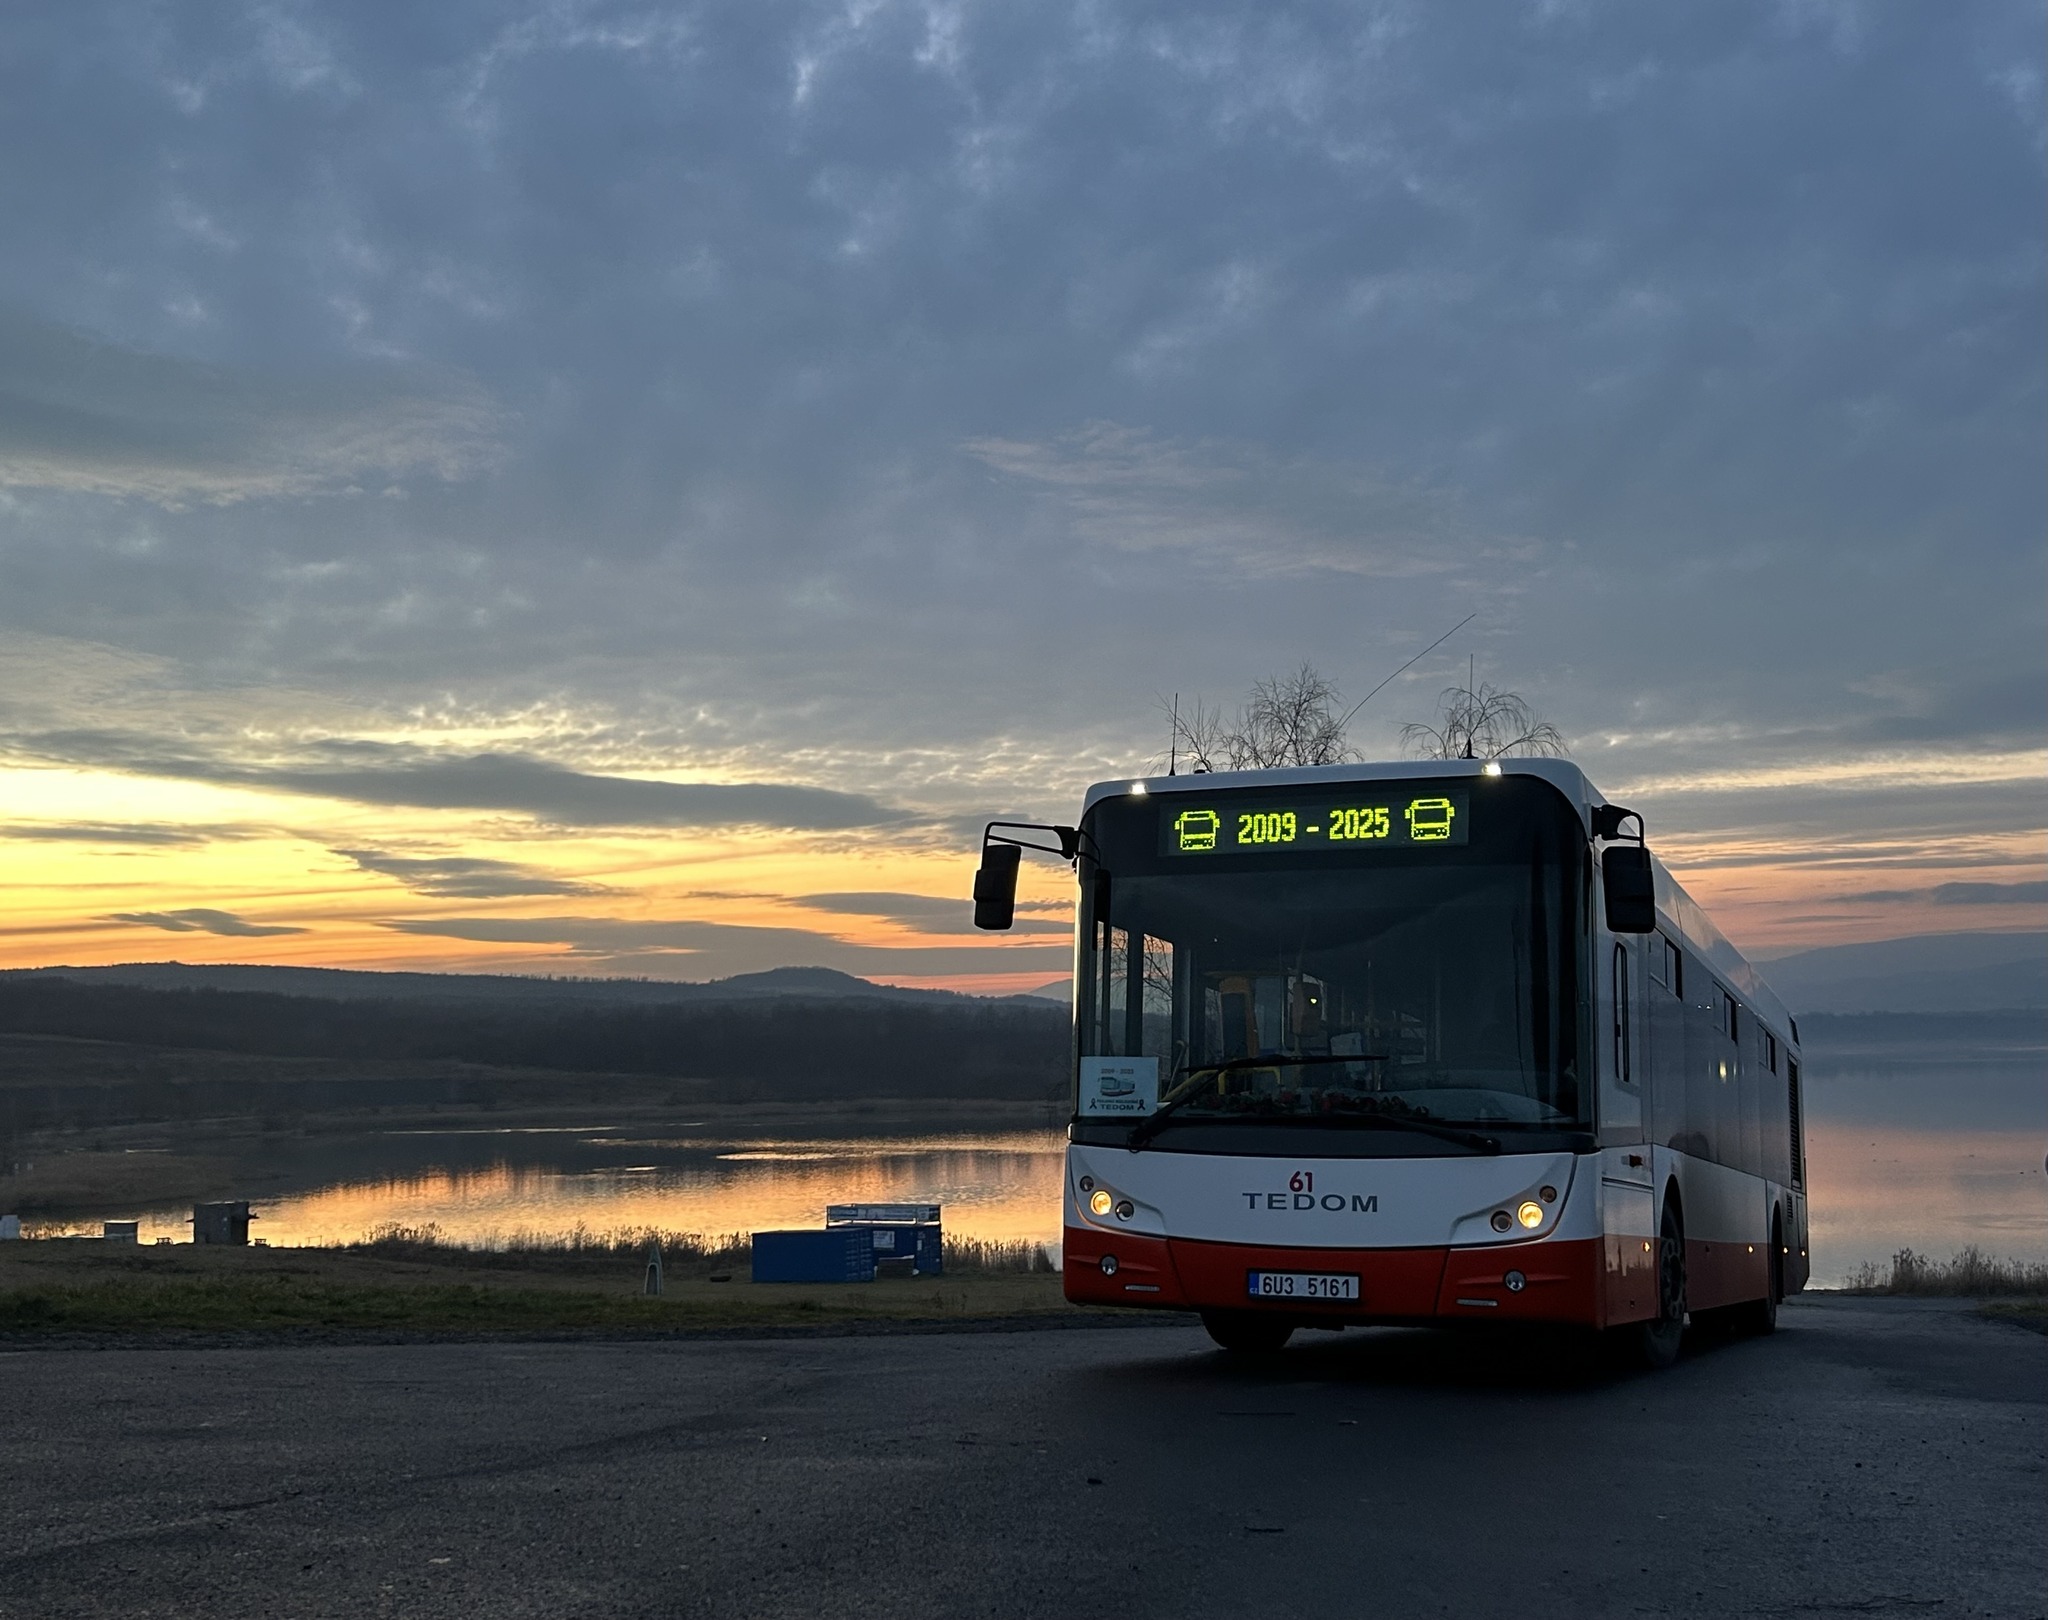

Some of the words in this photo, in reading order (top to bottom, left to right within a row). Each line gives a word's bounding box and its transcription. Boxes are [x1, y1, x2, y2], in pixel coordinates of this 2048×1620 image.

[1238, 812, 1296, 844] 2009
[1329, 807, 1389, 840] 2025
[1289, 1170, 1313, 1193] 61
[1242, 1193, 1378, 1213] TEDOM
[1263, 1276, 1294, 1295] 6U3
[1308, 1277, 1350, 1298] 5161
